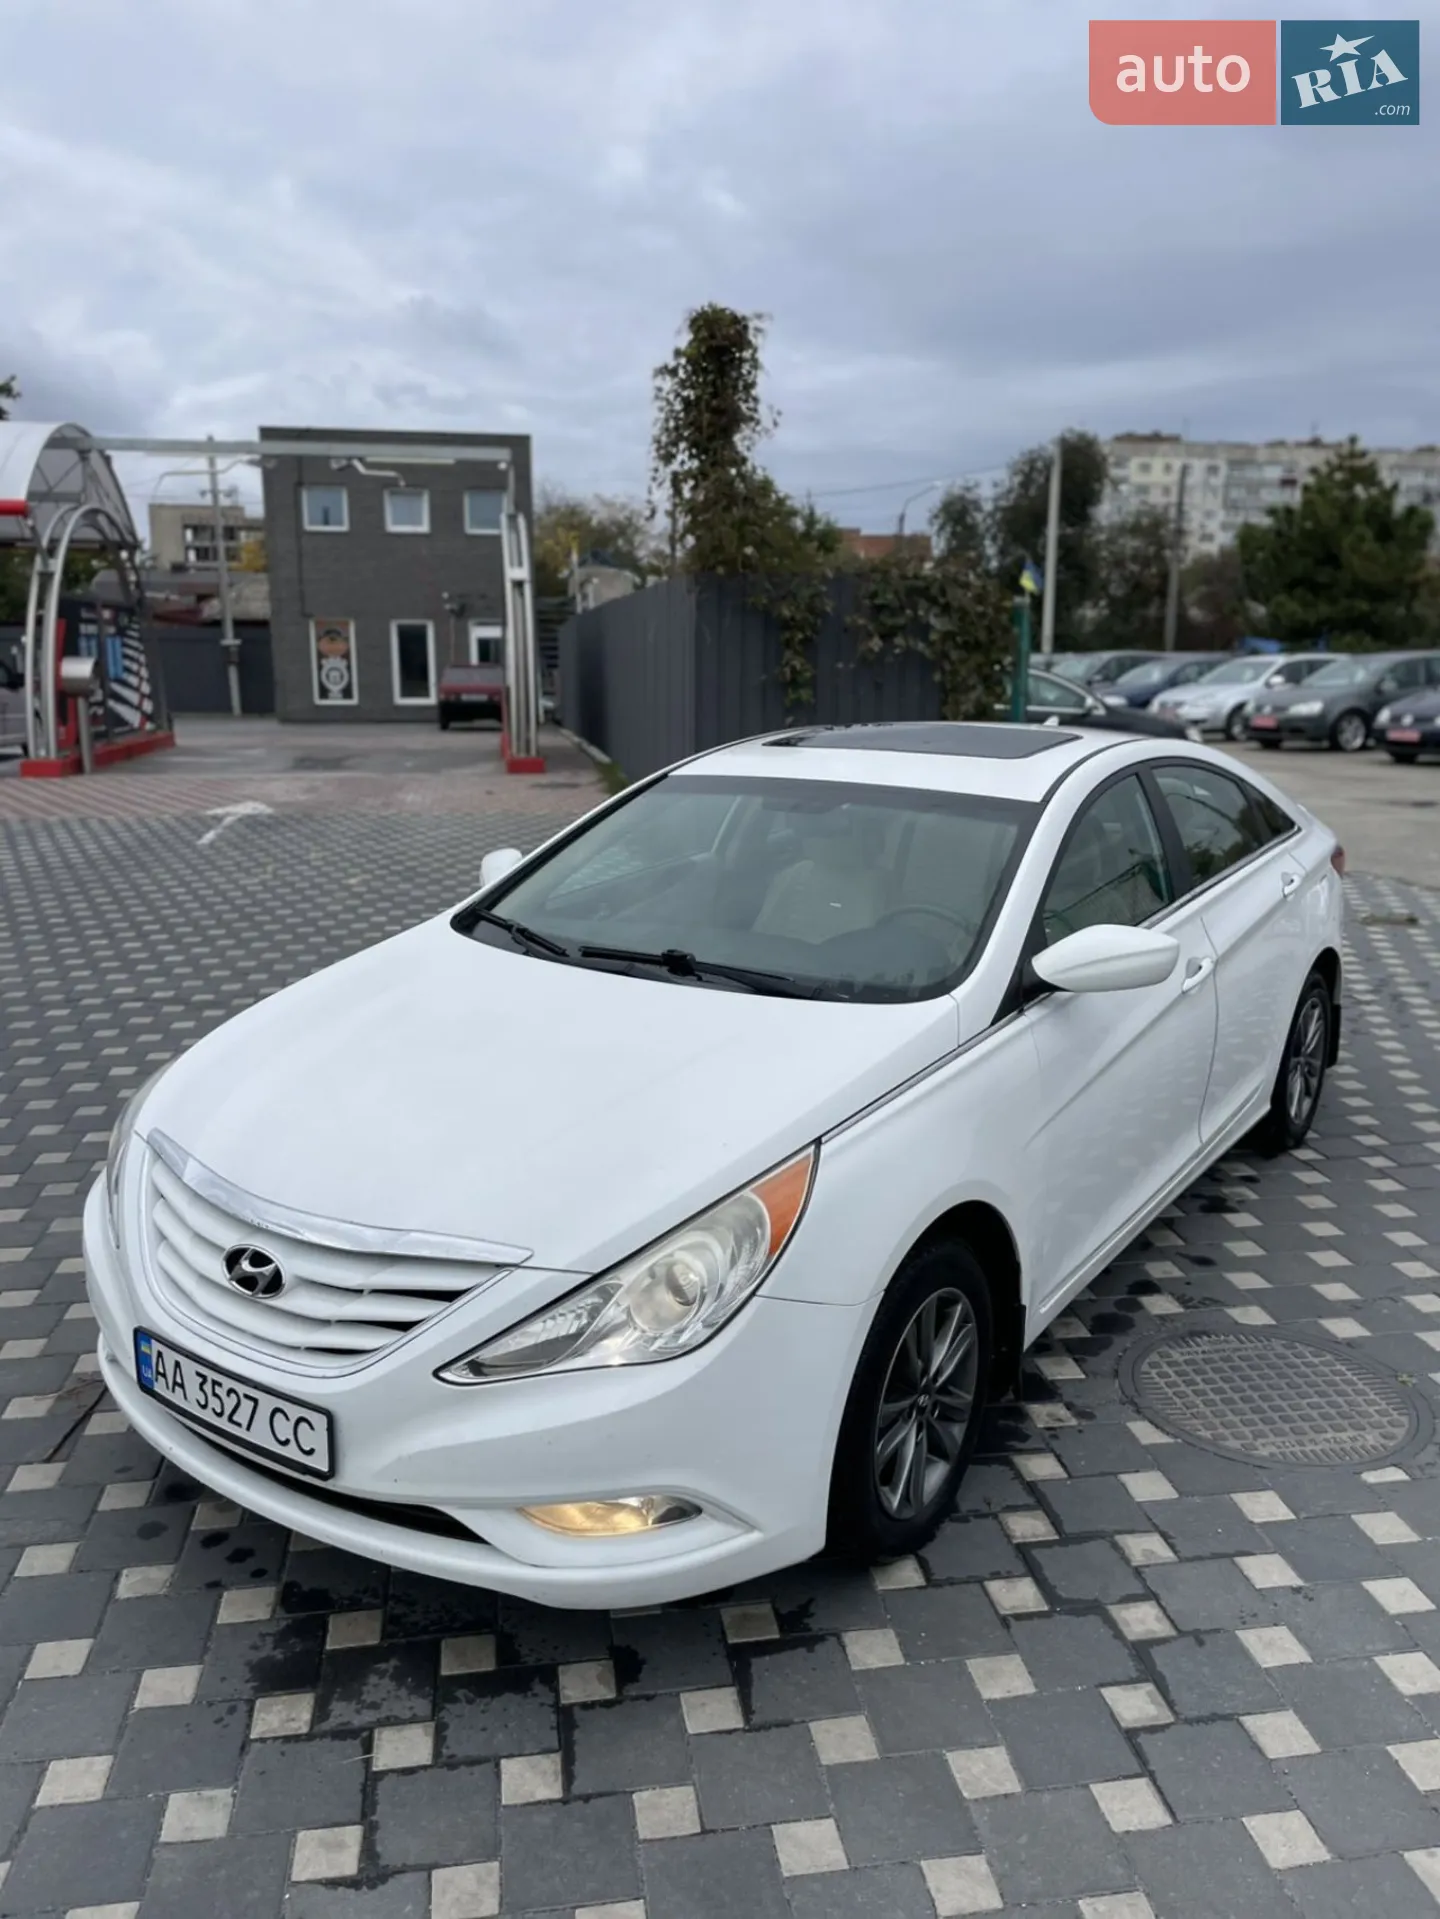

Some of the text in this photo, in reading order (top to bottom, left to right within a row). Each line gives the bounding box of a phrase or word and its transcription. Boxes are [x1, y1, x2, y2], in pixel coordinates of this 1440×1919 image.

[155, 1351, 315, 1456] AA 3527 CC
